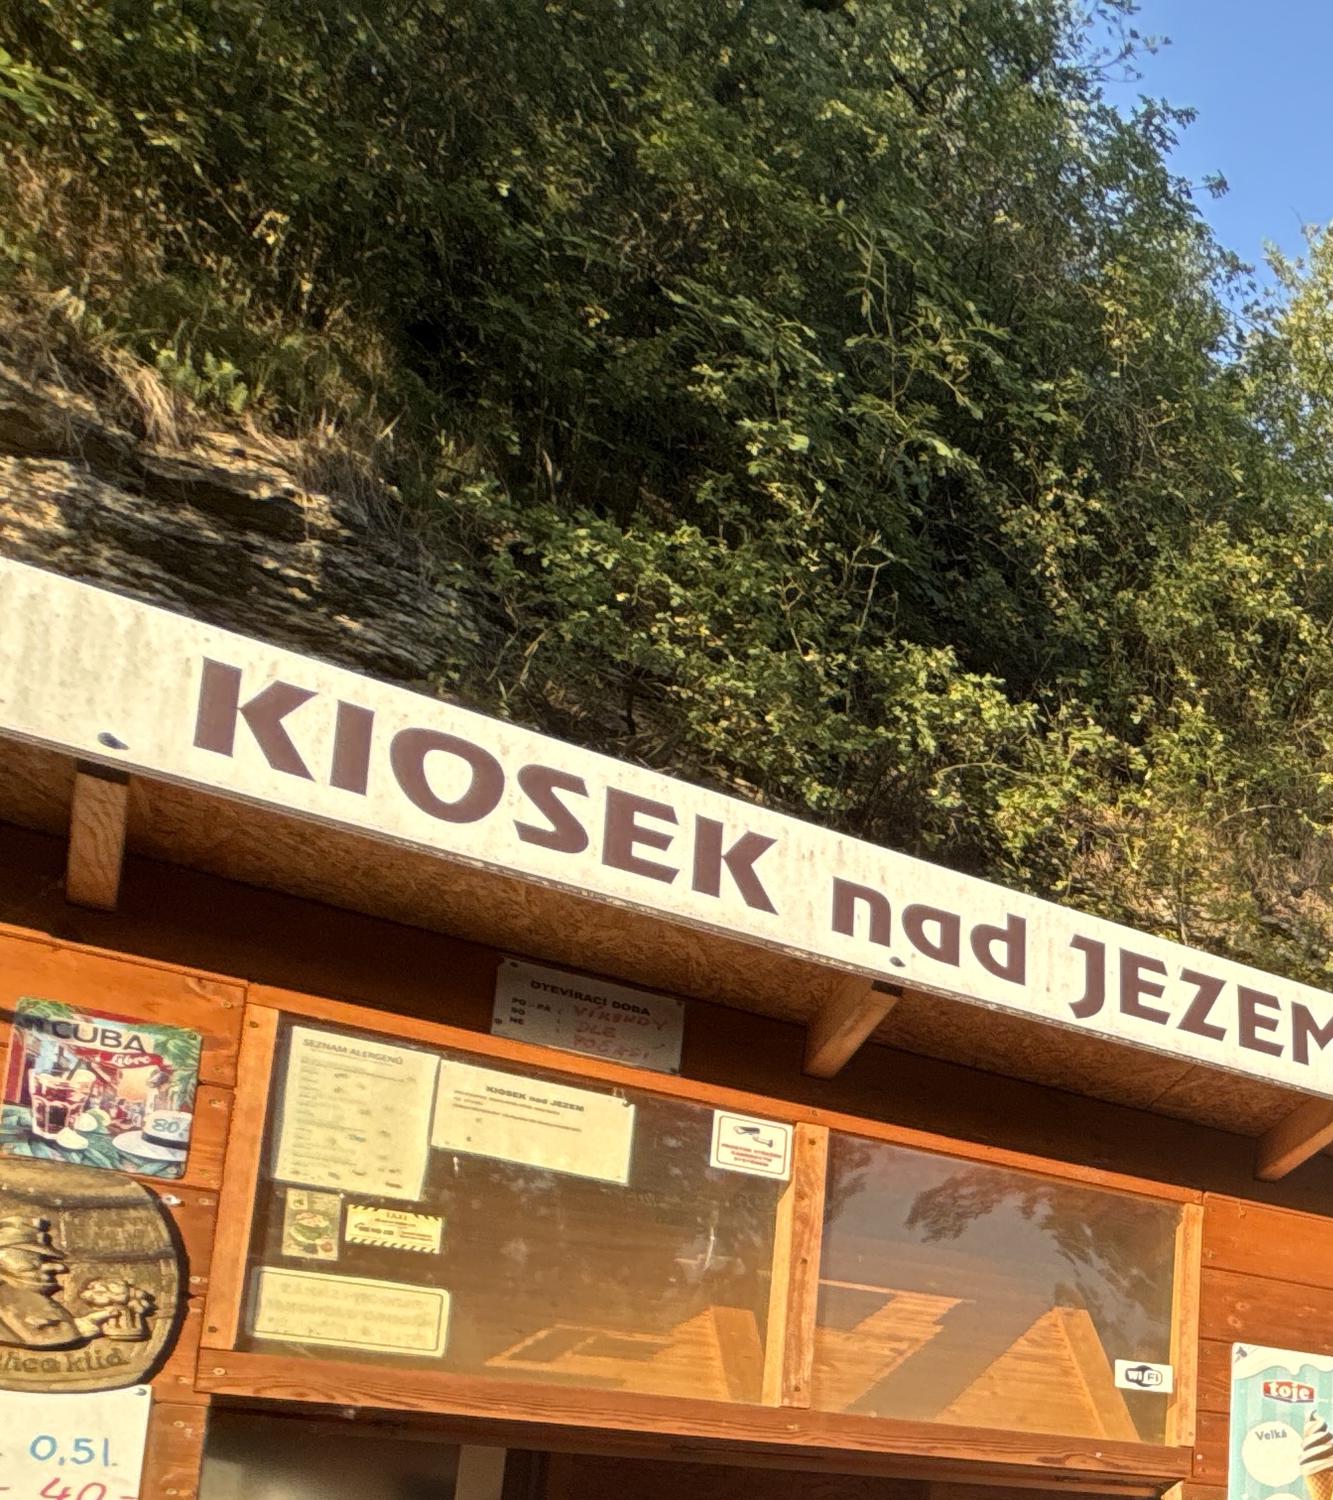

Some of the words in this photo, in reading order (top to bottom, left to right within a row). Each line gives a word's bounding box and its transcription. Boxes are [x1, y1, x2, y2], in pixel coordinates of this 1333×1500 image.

[193, 656, 779, 916] KIOSEK
[831, 876, 1026, 985] nad
[612, 1000, 650, 1016] DOBA
[52, 1020, 147, 1053] CUBA
[302, 1038, 347, 1054] SEZNAM
[486, 1086, 527, 1101] KIOSEK
[550, 1099, 585, 1113] JEZEM
[1268, 1382, 1311, 1402] toje
[1255, 1429, 1288, 1441] Velká
